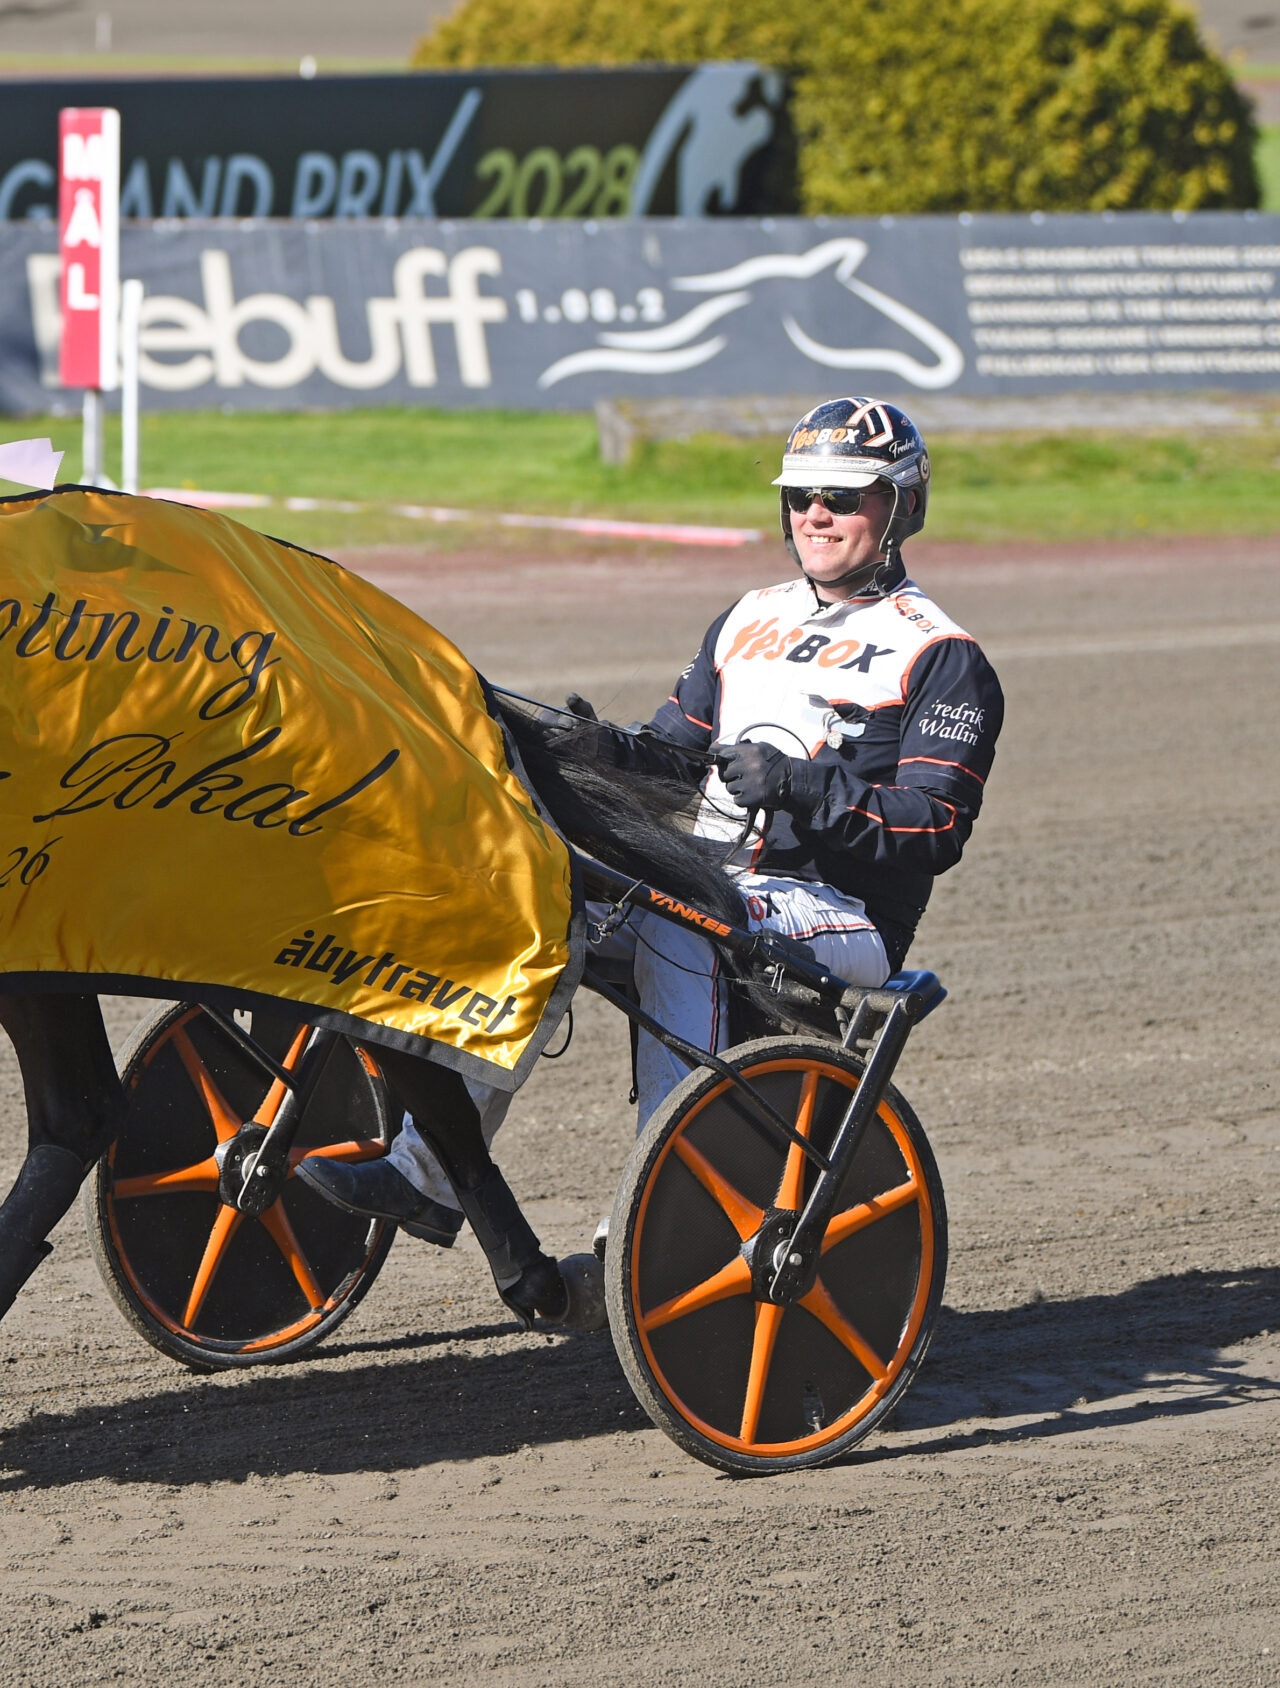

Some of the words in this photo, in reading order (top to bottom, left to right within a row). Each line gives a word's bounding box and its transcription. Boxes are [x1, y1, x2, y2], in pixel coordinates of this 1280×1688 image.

[63, 133, 102, 311] MÅL
[33, 727, 400, 837] Pokal
[918, 718, 979, 746] Wallin
[648, 889, 732, 938] YANKEE
[274, 929, 519, 1034] åbytravet
